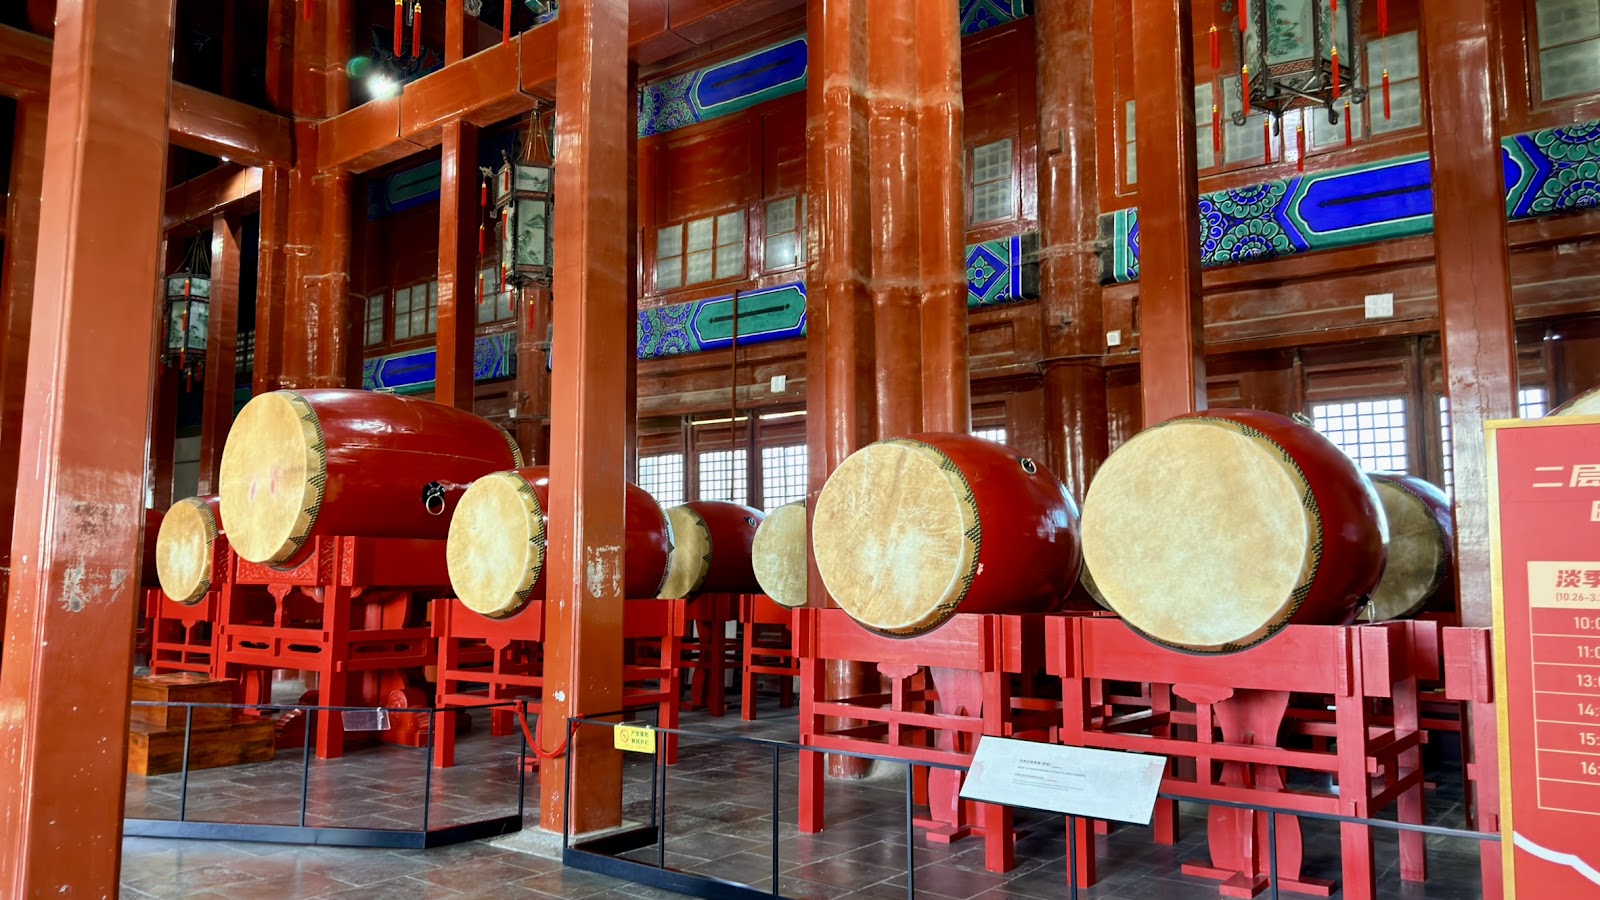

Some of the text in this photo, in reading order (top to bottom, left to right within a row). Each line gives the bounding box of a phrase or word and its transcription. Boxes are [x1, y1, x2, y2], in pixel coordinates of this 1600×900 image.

[1555, 569, 1600, 589] 淡季
[1555, 592, 1600, 602] (10.26-3.
[1576, 674, 1600, 688] 13:
